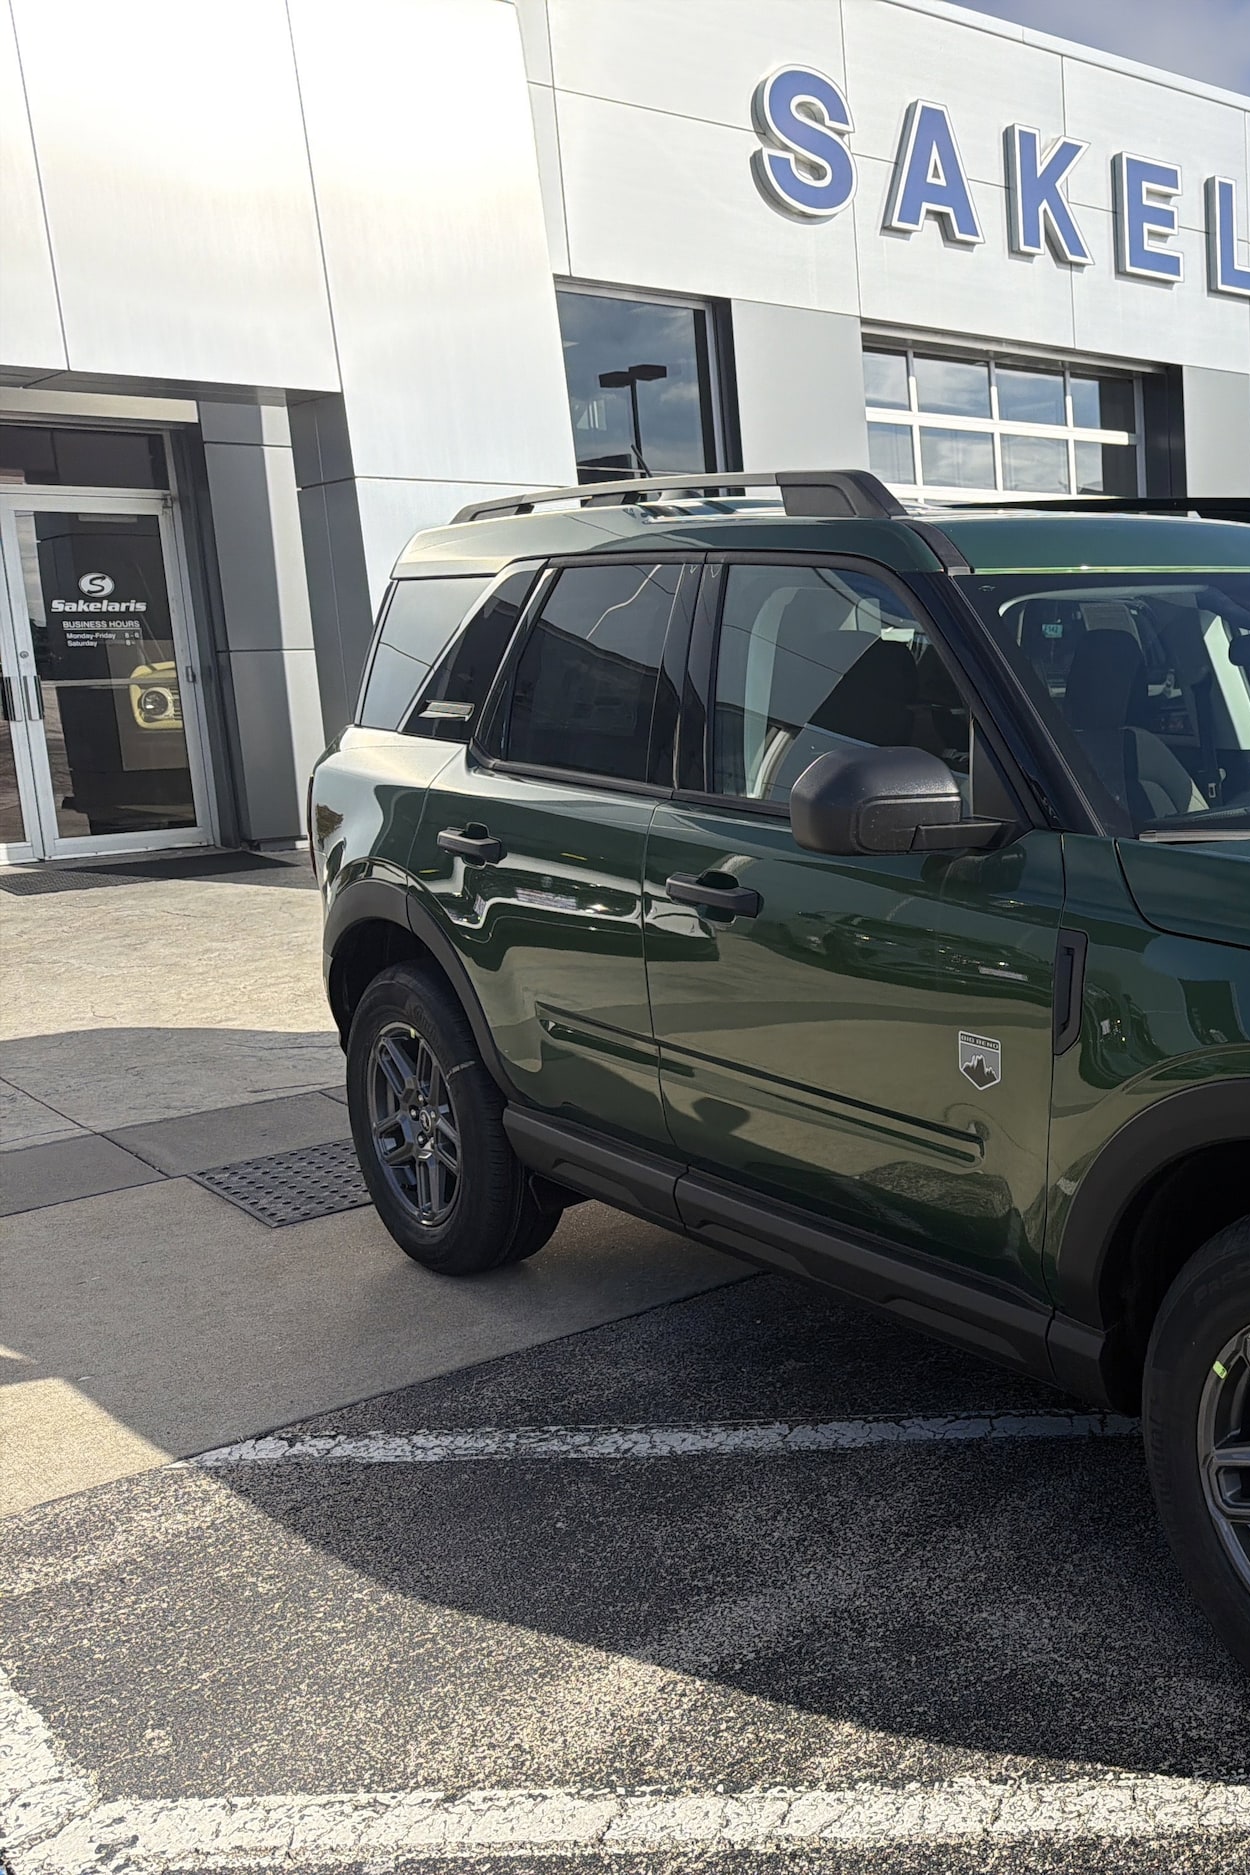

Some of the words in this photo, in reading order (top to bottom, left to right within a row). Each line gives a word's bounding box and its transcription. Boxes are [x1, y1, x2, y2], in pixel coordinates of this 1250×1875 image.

[51, 599, 147, 613] Sakelaris
[63, 620, 108, 628] BUSINESS
[109, 620, 140, 628] HOURS
[66, 632, 116, 640] Monday-Friday
[960, 1034, 975, 1043] BIG
[976, 1040, 999, 1050] BEND
